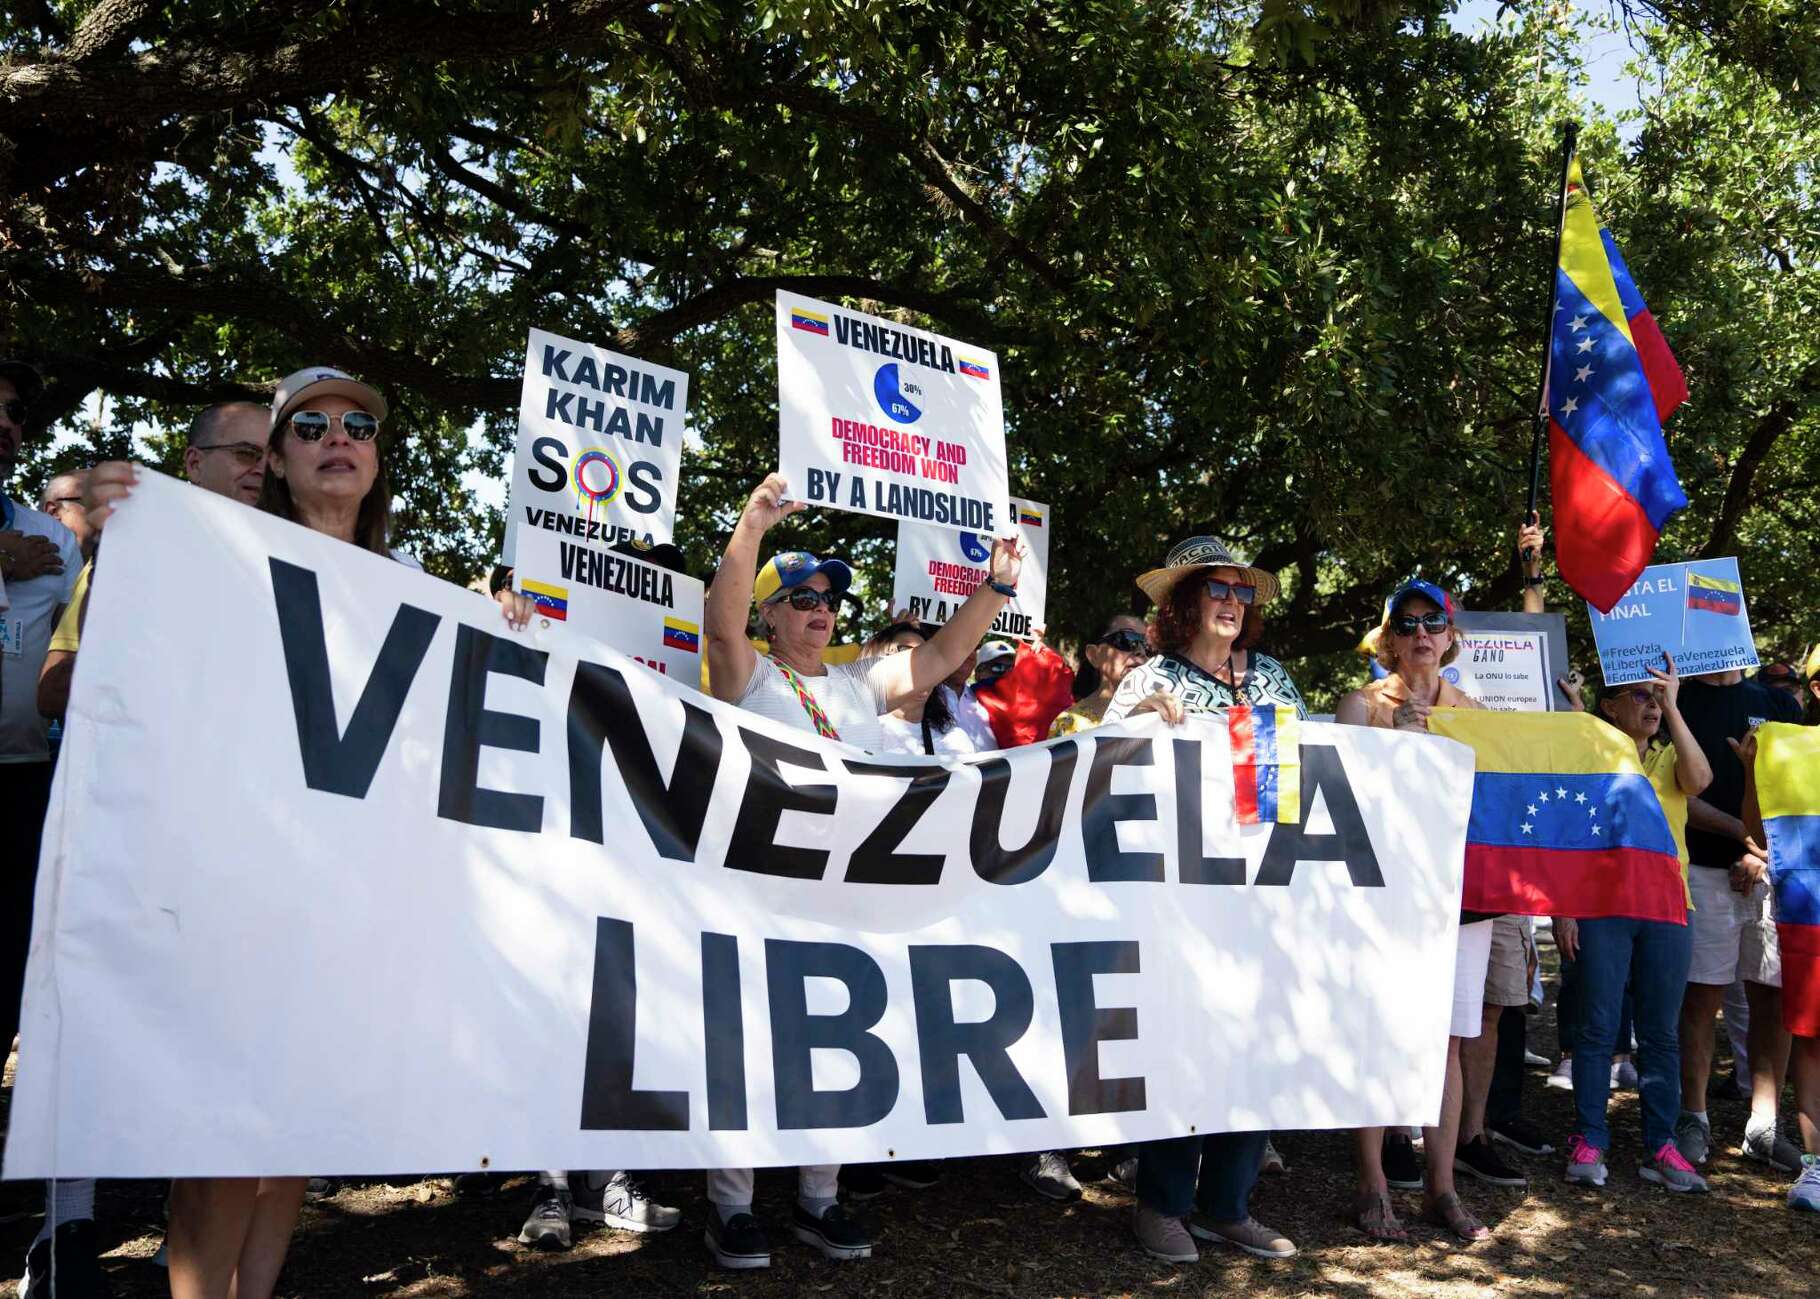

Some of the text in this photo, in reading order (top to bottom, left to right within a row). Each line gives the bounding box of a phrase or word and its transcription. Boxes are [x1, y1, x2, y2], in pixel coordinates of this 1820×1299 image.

[834, 314, 956, 374] VENEZUELA
[542, 345, 675, 410] KARIM
[904, 382, 922, 396] 30%
[545, 388, 664, 447] KHAN
[892, 402, 909, 417] 67%
[832, 417, 967, 466] DEMOCRACY AND
[843, 441, 959, 485] FREEDOM WON
[528, 437, 663, 514] SOS
[807, 467, 841, 504] BY
[850, 476, 866, 509] A
[875, 480, 995, 532] LANDSLIDE
[560, 541, 674, 609] VENEZUELA
[929, 560, 990, 582] DEMOCRAC
[1658, 577, 1678, 593] EL
[909, 596, 931, 620] BY
[936, 601, 947, 623] A
[1603, 642, 1662, 659] #FreeVzla
[1475, 672, 1529, 680] La ONU lo sabe
[268, 557, 1386, 888] VENEZUELA
[580, 917, 1146, 1132] LIBRE
